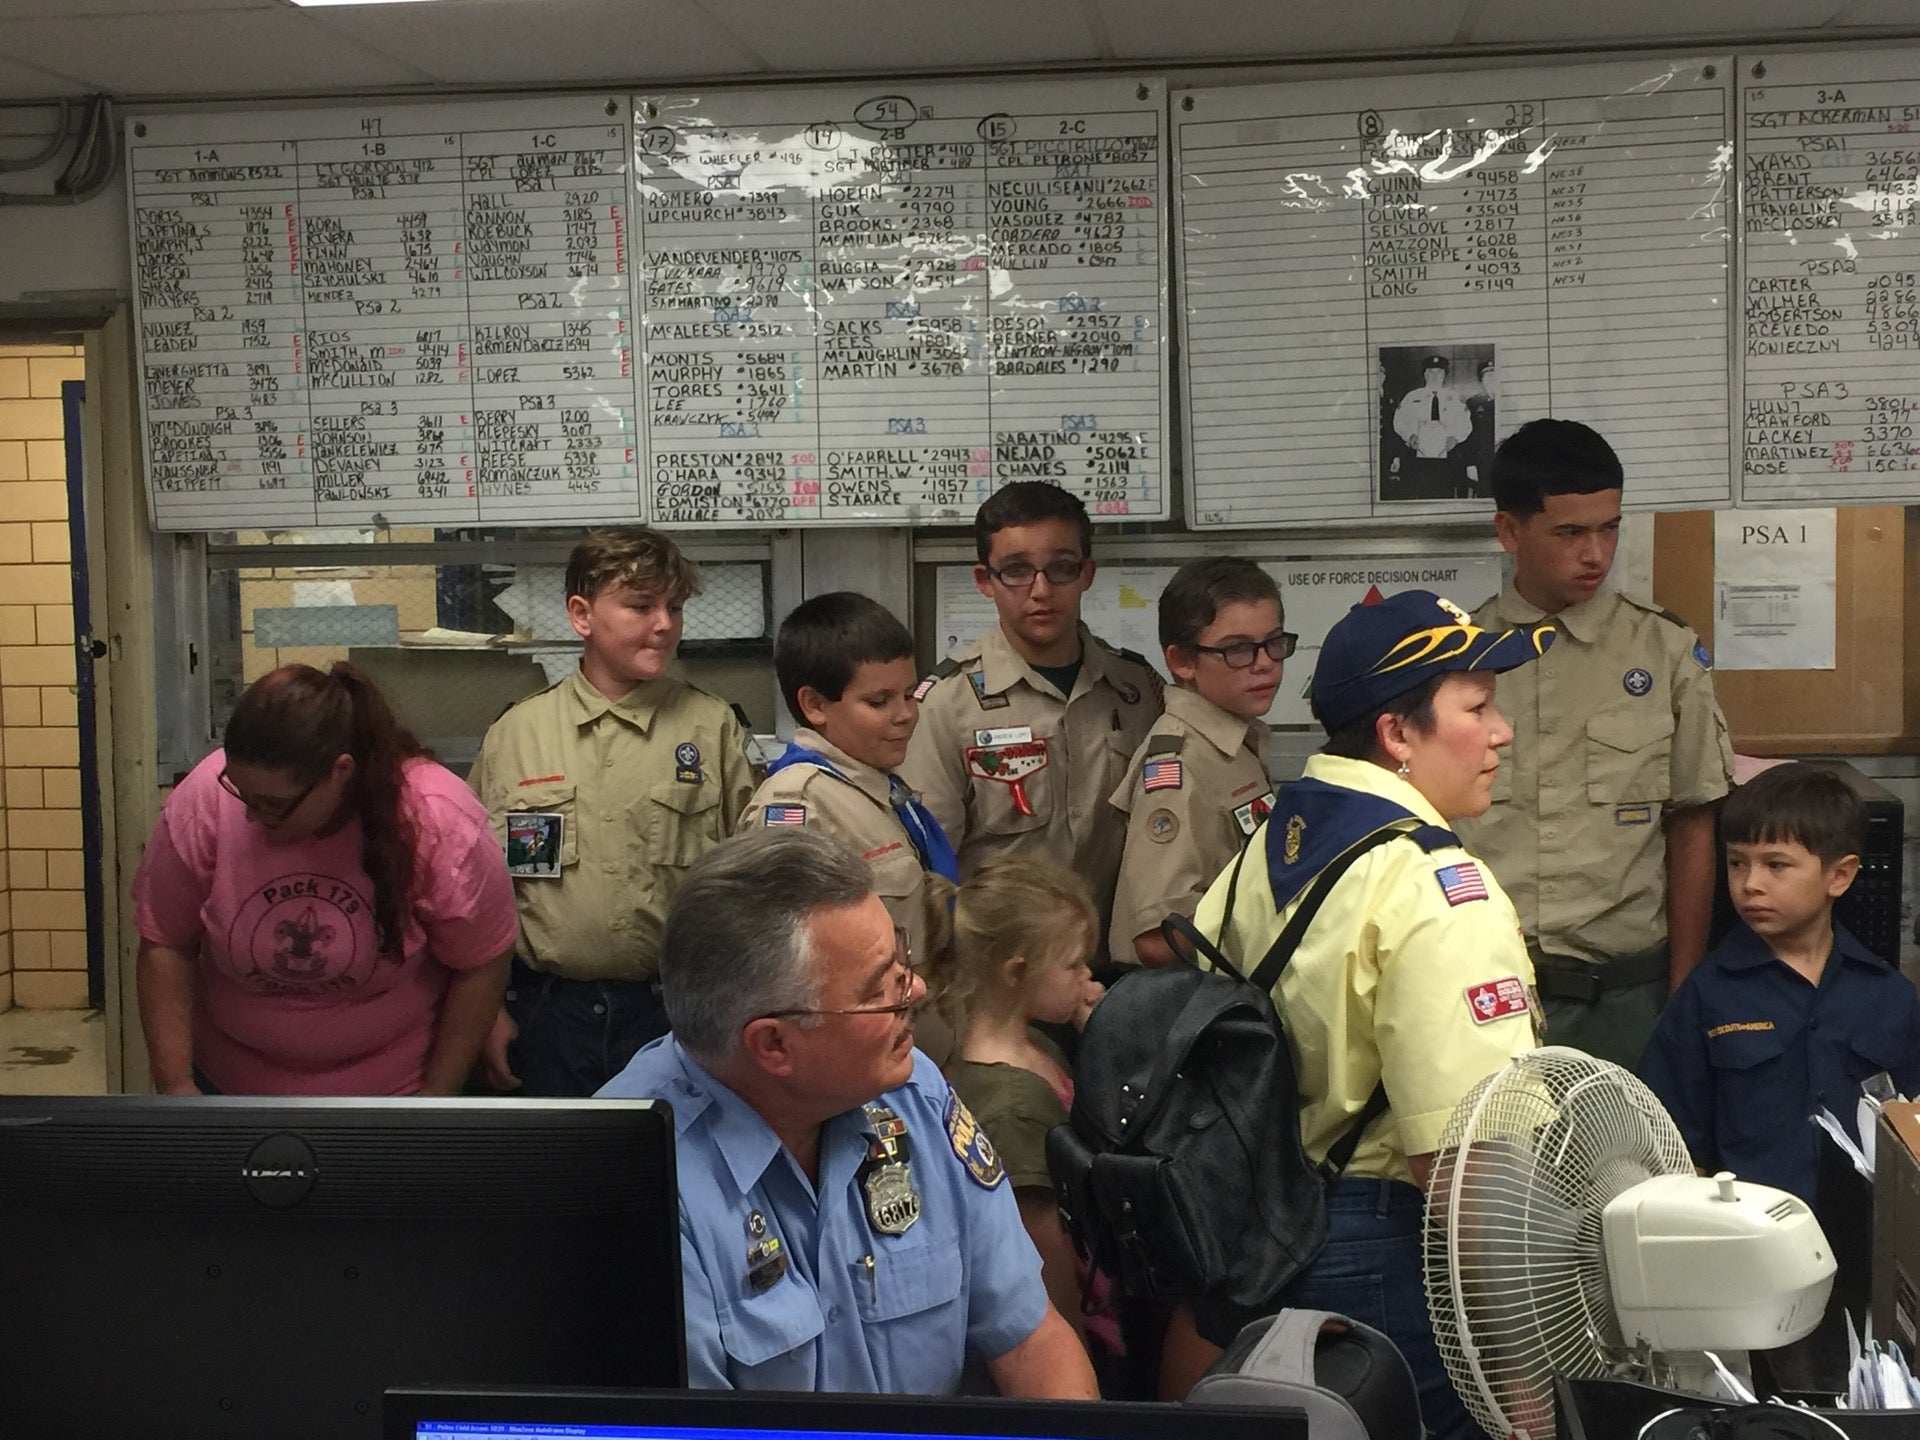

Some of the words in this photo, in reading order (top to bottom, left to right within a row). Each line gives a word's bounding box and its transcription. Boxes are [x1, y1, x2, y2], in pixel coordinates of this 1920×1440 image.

[1818, 90, 1846, 103] 3-A
[361, 117, 381, 136] 47
[1060, 121, 1085, 133] 2-C
[1751, 113, 1789, 128] SGT
[881, 129, 905, 140] 2-B
[991, 122, 1006, 137] 15
[532, 135, 556, 147] 1-C
[195, 150, 219, 162] 1-A
[362, 144, 385, 155] 1-B
[700, 153, 761, 165] WHEELER
[1866, 152, 1916, 165] 3656
[1746, 173, 1811, 187] BRENT
[650, 192, 713, 206] ROMERO
[820, 187, 882, 202] HOEHN
[1372, 193, 1418, 206] TRAN
[1746, 187, 1845, 201] PATTERSON
[821, 205, 861, 218] GUK
[991, 198, 1049, 213] YOUNG
[563, 208, 592, 220] 3185
[648, 208, 735, 221] UPCHURCH
[991, 213, 1064, 228] VASQUEZ
[1369, 208, 1428, 223] OLIVER
[820, 219, 893, 232] BROOKS
[1370, 222, 1447, 237] SEISLOVE
[1369, 237, 1448, 252] MAZZONI
[1372, 266, 1426, 280] SMITH
[822, 276, 894, 289] WATSON
[1748, 279, 1811, 293] CARTER
[1371, 283, 1417, 297] LONG
[1748, 294, 1820, 310] WILMER
[1745, 307, 1842, 323] ROBERTSON
[824, 320, 882, 336] SACKS
[1748, 324, 1829, 338] ACEVEDO
[1867, 320, 1919, 333] 5309
[309, 331, 350, 346] RIOS
[824, 336, 873, 349] TEES
[1748, 339, 1839, 356] KONIECZNY
[651, 352, 713, 365] MONTS
[477, 368, 520, 382] LOPEZ
[652, 367, 722, 381] MURPHY
[823, 363, 896, 379] MARTIN
[653, 384, 722, 397] TORRES
[655, 400, 685, 411] LEE
[313, 417, 366, 431] SELLERS
[1746, 413, 1830, 428] CRAWFORD
[995, 432, 1080, 445] SABATINO
[1748, 429, 1813, 445] LACKEY
[657, 453, 733, 467] PRESTON
[996, 447, 1054, 461] NEJAD
[1745, 446, 1832, 460] MARTINEZ
[997, 462, 1066, 476] CHAVES
[1745, 461, 1788, 474] ROSE
[829, 481, 891, 495] OWENS
[828, 493, 900, 506] STARACE
[1743, 525, 1788, 544] PSA
[1801, 525, 1806, 543] 1
[1288, 573, 1310, 585] USE
[1313, 572, 1327, 584] OF
[1329, 572, 1365, 584] FORCE
[1368, 570, 1419, 583] DECISION
[1422, 569, 1458, 582] CHART
[264, 879, 318, 904] Pack
[328, 886, 360, 914] 179
